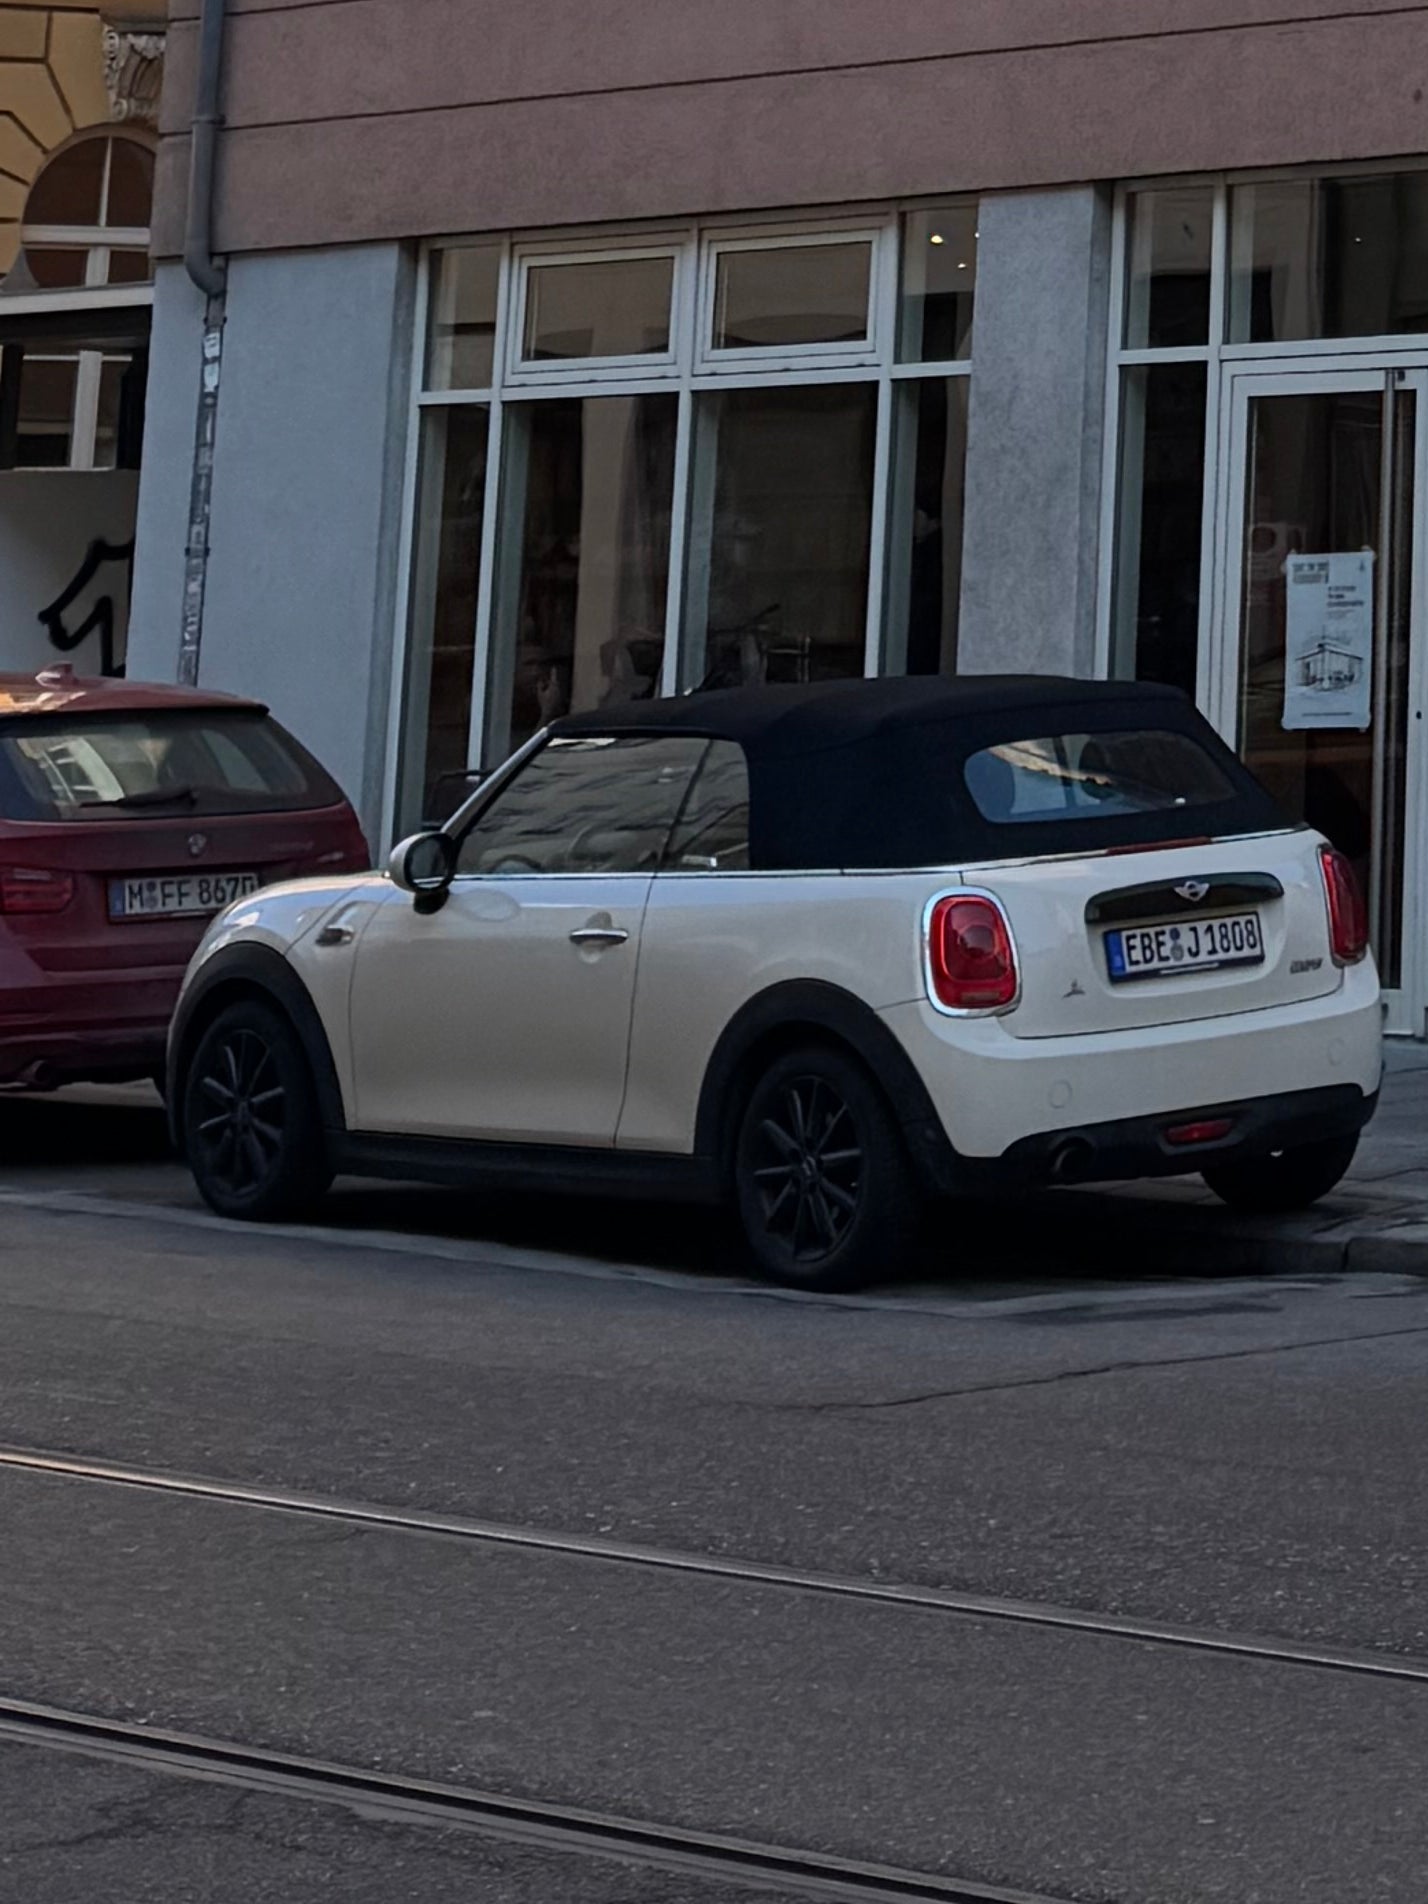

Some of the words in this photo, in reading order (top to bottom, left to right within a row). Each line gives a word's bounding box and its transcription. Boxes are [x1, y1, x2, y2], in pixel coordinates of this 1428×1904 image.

[128, 883, 144, 909] M
[161, 880, 190, 907] FF
[1125, 930, 1170, 966] EBE
[1187, 926, 1201, 958] J
[1204, 919, 1257, 956] 1808
